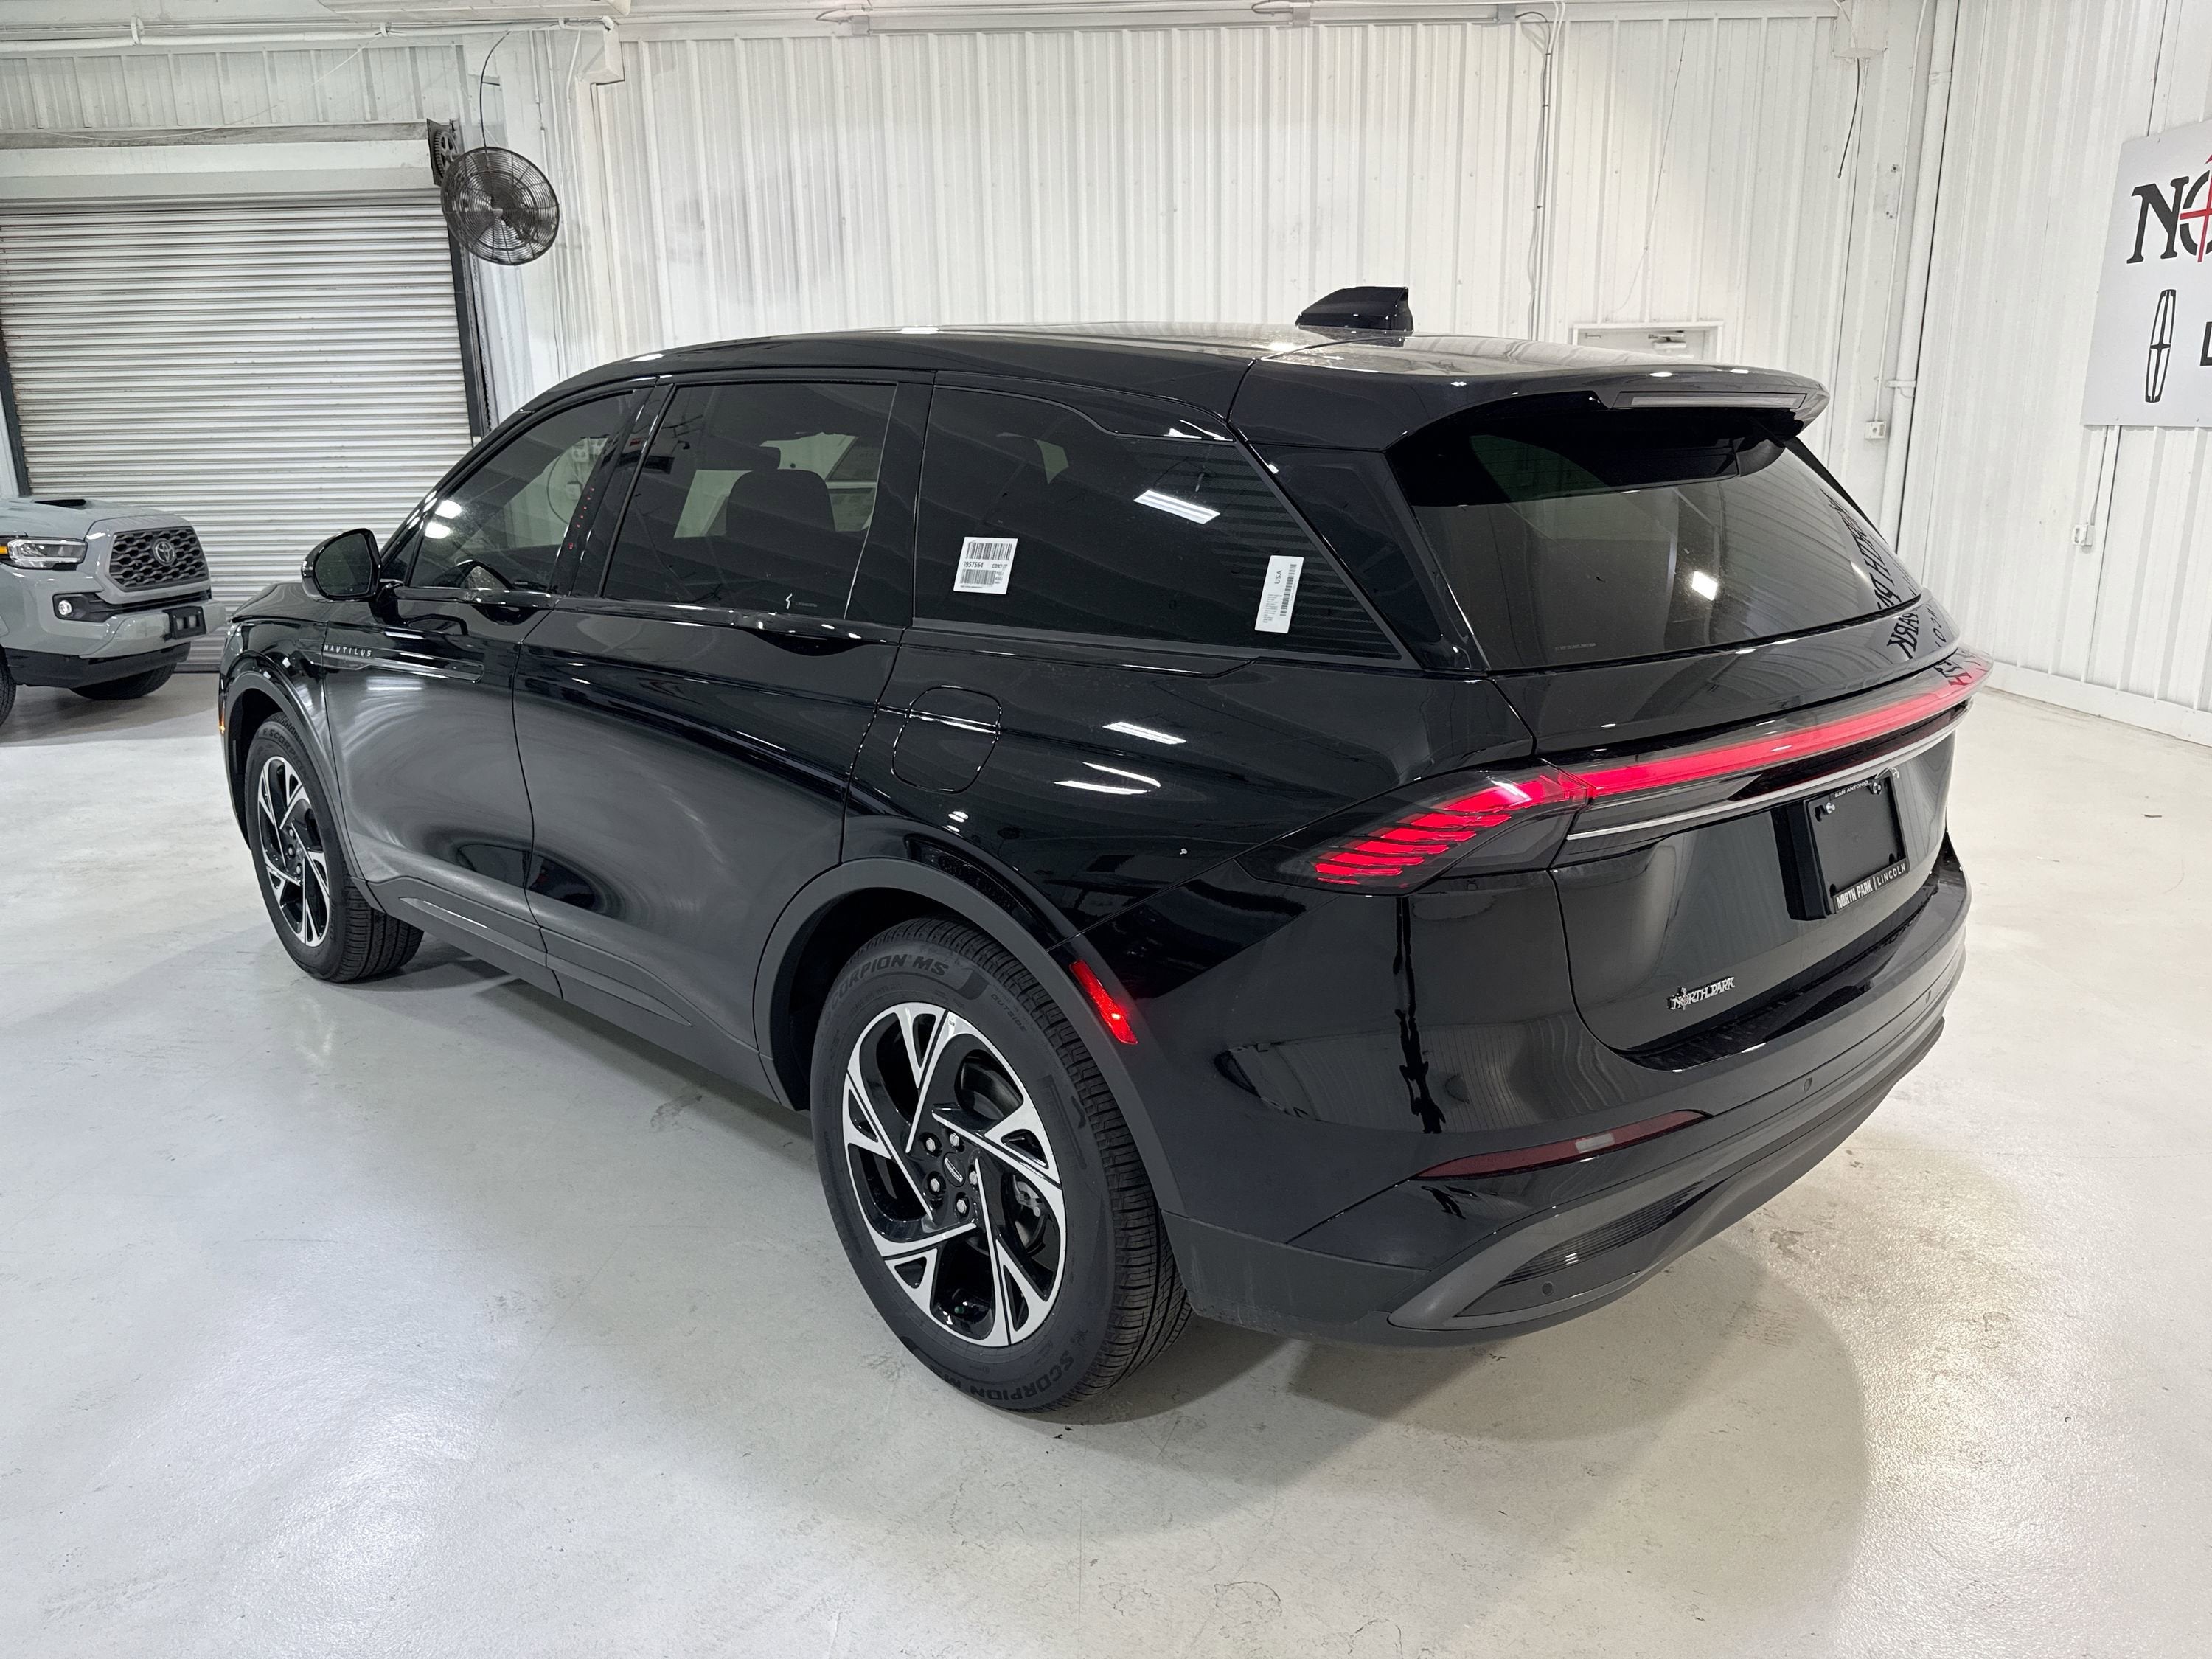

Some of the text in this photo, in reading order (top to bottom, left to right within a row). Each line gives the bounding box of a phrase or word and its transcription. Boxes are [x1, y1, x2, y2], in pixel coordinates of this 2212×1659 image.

[1274, 570, 1282, 584] USA
[324, 644, 372, 657] NAUTILUS
[1834, 780, 1869, 798] SAN ANTONIO
[1836, 863, 1906, 910] NORTH PARK LINCOLN
[912, 956, 950, 976] MS
[1669, 976, 1735, 1010] NORTH PARK
[991, 994, 1028, 1033] OUTSIDE
[970, 1350, 1074, 1402] SCORPION
